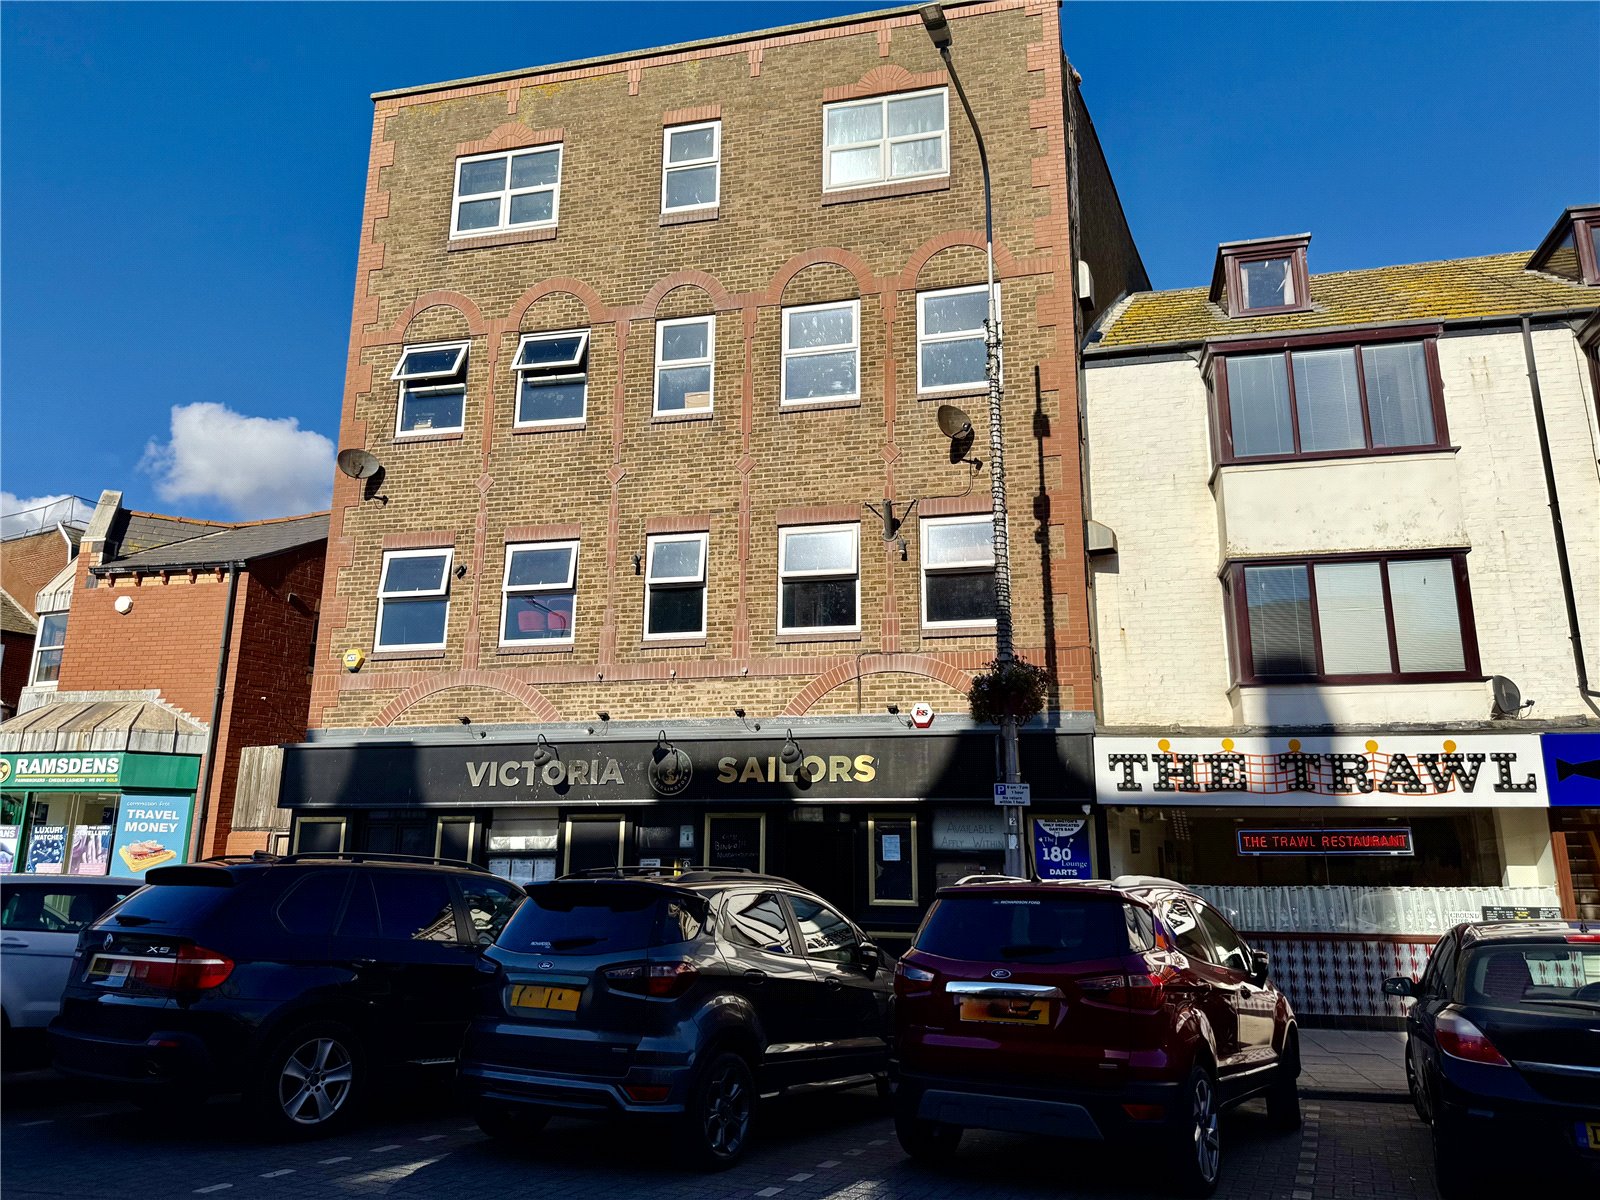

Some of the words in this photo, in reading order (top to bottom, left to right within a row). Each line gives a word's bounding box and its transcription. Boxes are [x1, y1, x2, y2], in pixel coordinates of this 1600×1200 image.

[16, 758, 119, 774] RAMSDENS
[716, 754, 876, 783] SAILORS
[466, 760, 624, 787] VICTORIA
[1108, 753, 1247, 792] THE
[1279, 753, 1537, 794] TRAWL
[998, 786, 1004, 794] P
[128, 809, 180, 820] TRAVEL
[124, 822, 178, 832] MONEY
[1243, 836, 1268, 848] THE
[1272, 836, 1316, 848] TRAWL
[1322, 835, 1406, 848] RESTAURANT
[1042, 846, 1072, 862] 180
[1062, 860, 1088, 868] Lounge
